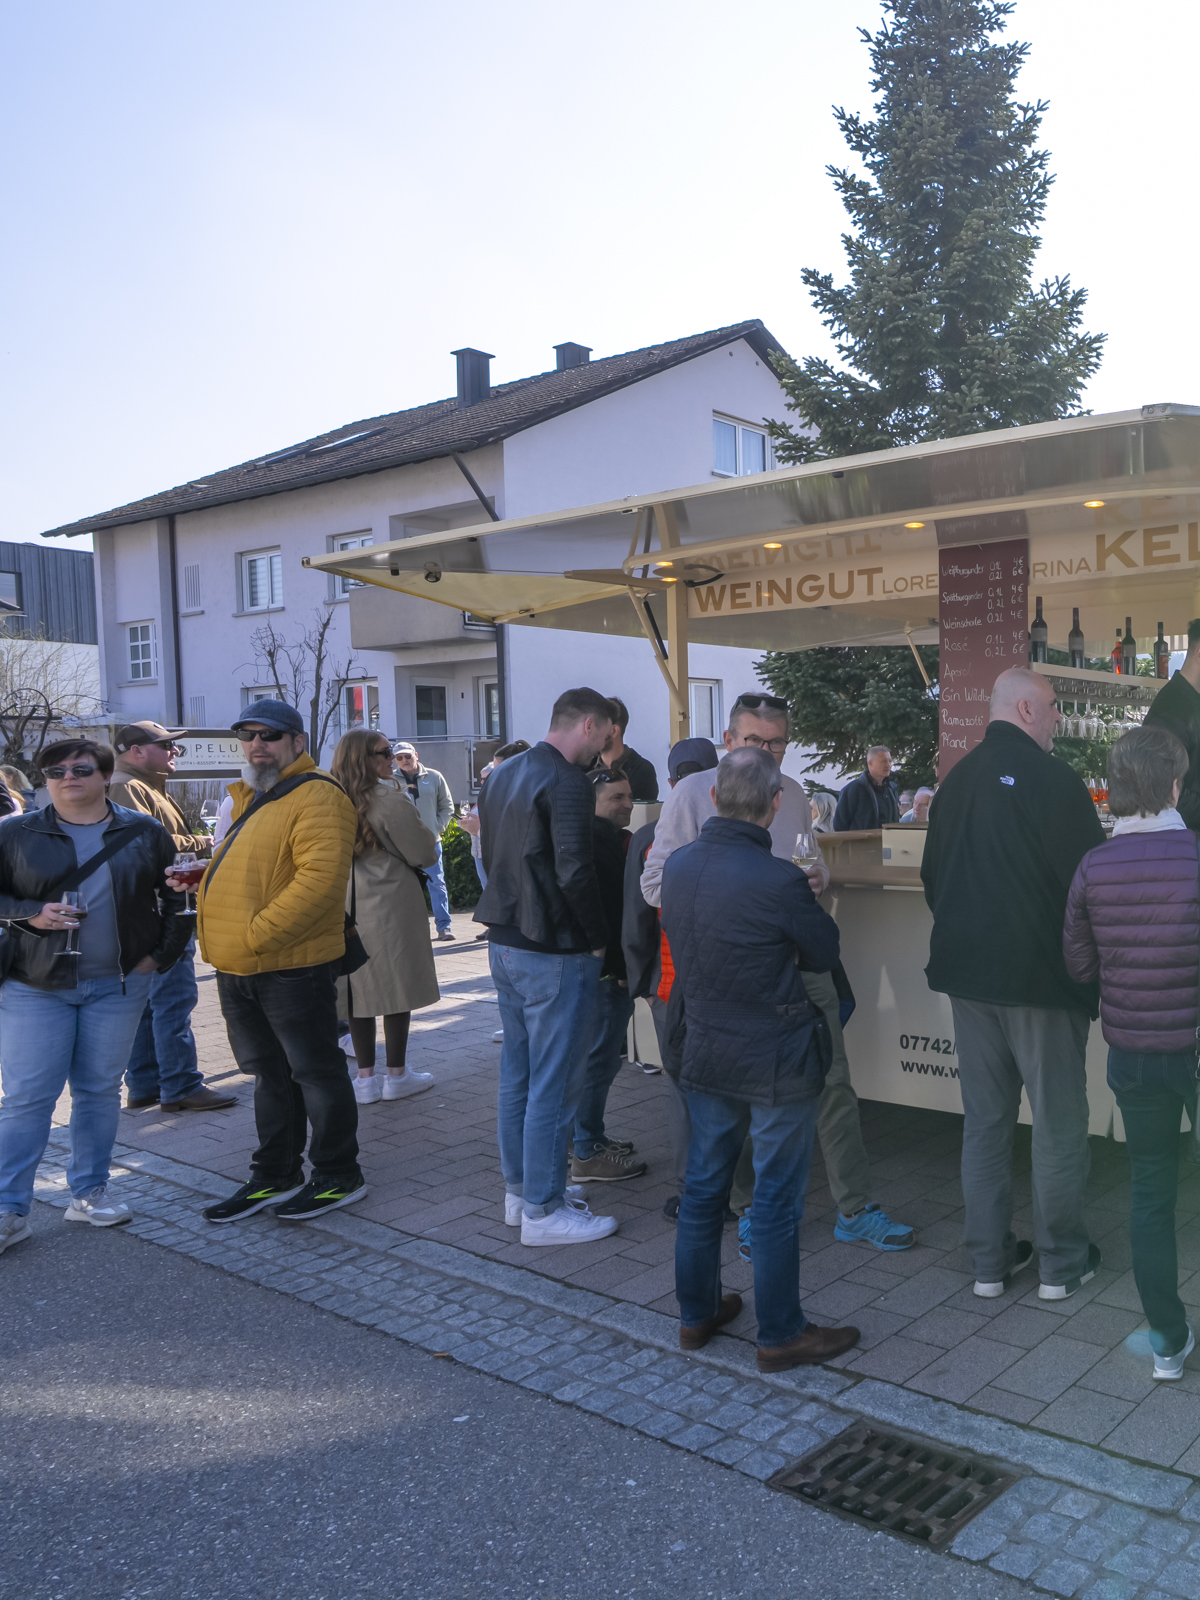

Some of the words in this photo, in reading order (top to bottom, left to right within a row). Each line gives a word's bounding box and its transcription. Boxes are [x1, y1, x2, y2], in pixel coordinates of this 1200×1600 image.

[1012, 565, 1024, 576] 6€
[694, 566, 883, 612] WEINGUT
[1032, 557, 1091, 579] RINA
[943, 636, 970, 652] Rosé
[943, 662, 972, 682] Aperol
[941, 687, 961, 702] Gin
[941, 731, 968, 751] Pfand
